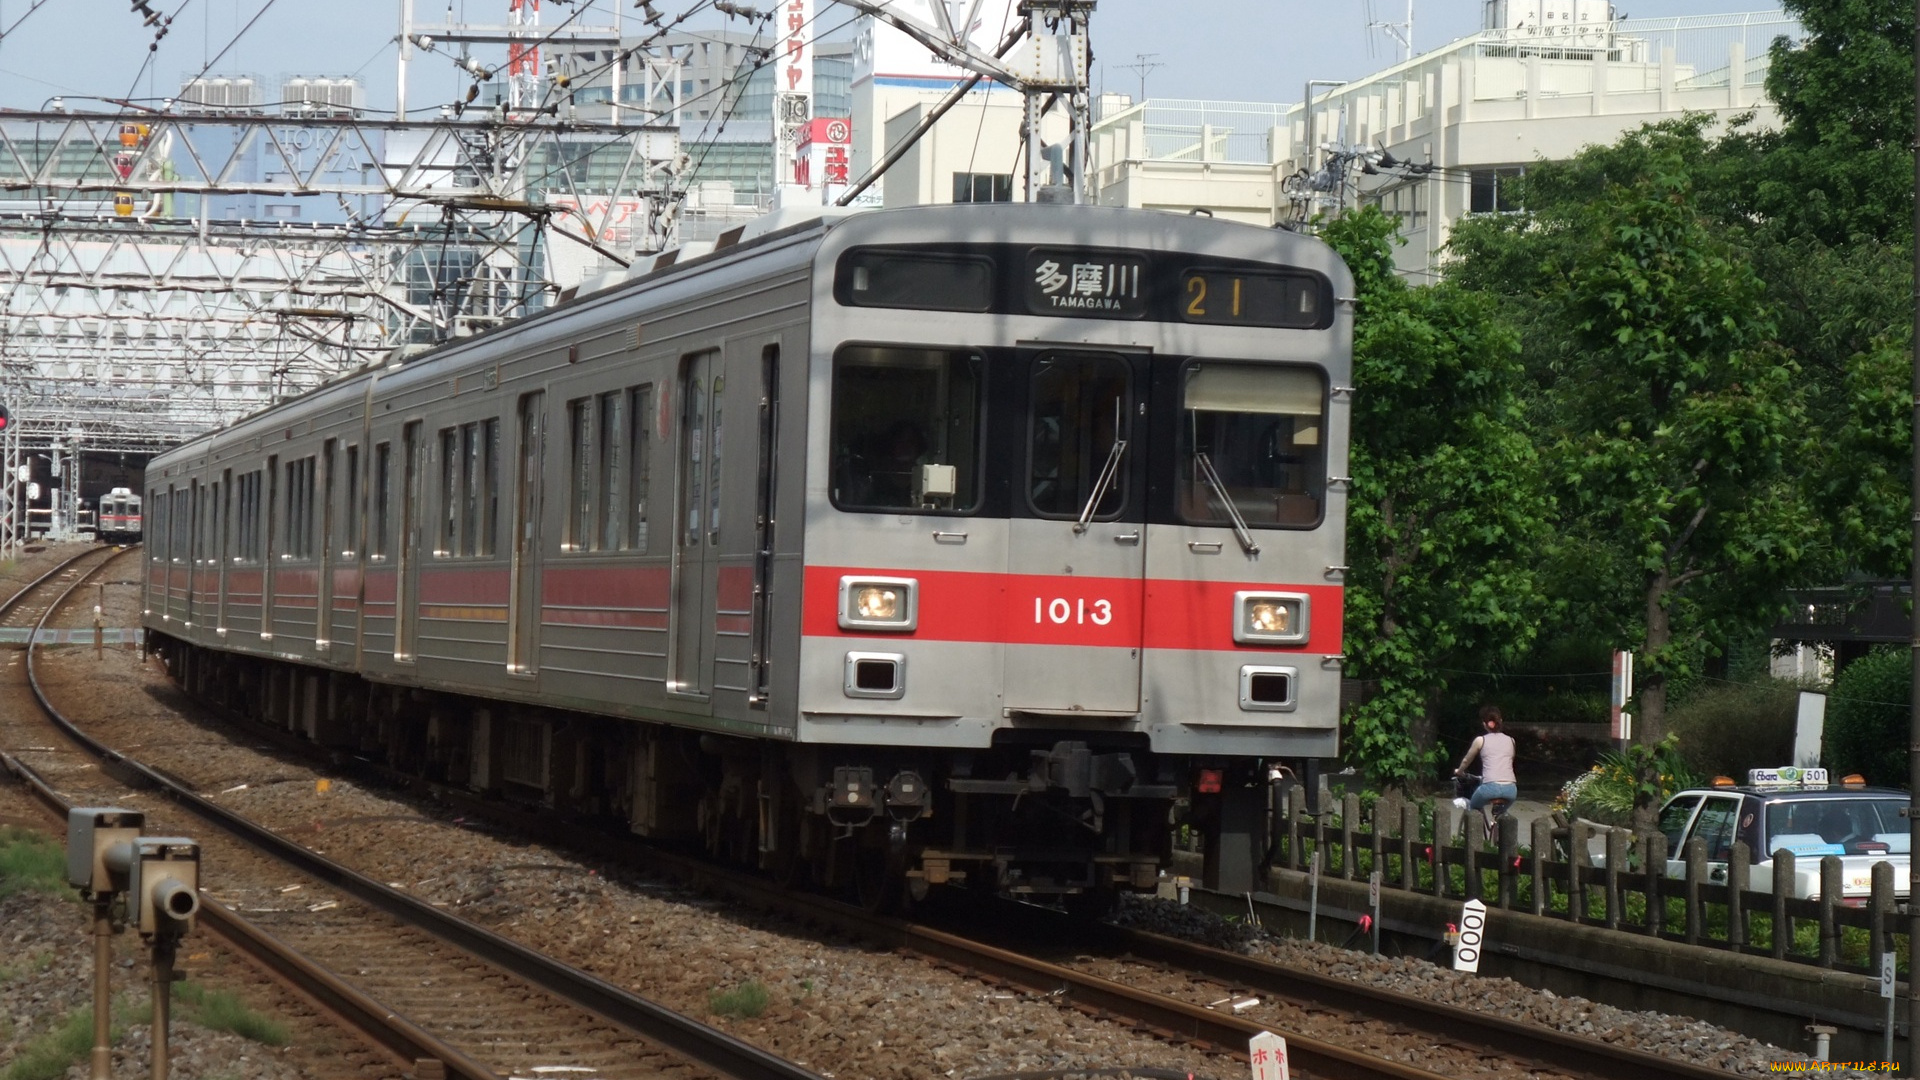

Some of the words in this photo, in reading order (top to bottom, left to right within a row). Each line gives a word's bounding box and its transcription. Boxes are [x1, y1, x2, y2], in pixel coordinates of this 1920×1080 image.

[280, 151, 362, 173] PLZA
[1035, 260, 1138, 298] 多摩川
[1051, 295, 1121, 311] TAMAGAWA
[1035, 597, 1112, 626] 1013
[1806, 770, 1826, 781] 501
[1458, 906, 1485, 963] 1000
[1884, 966, 1892, 985] S
